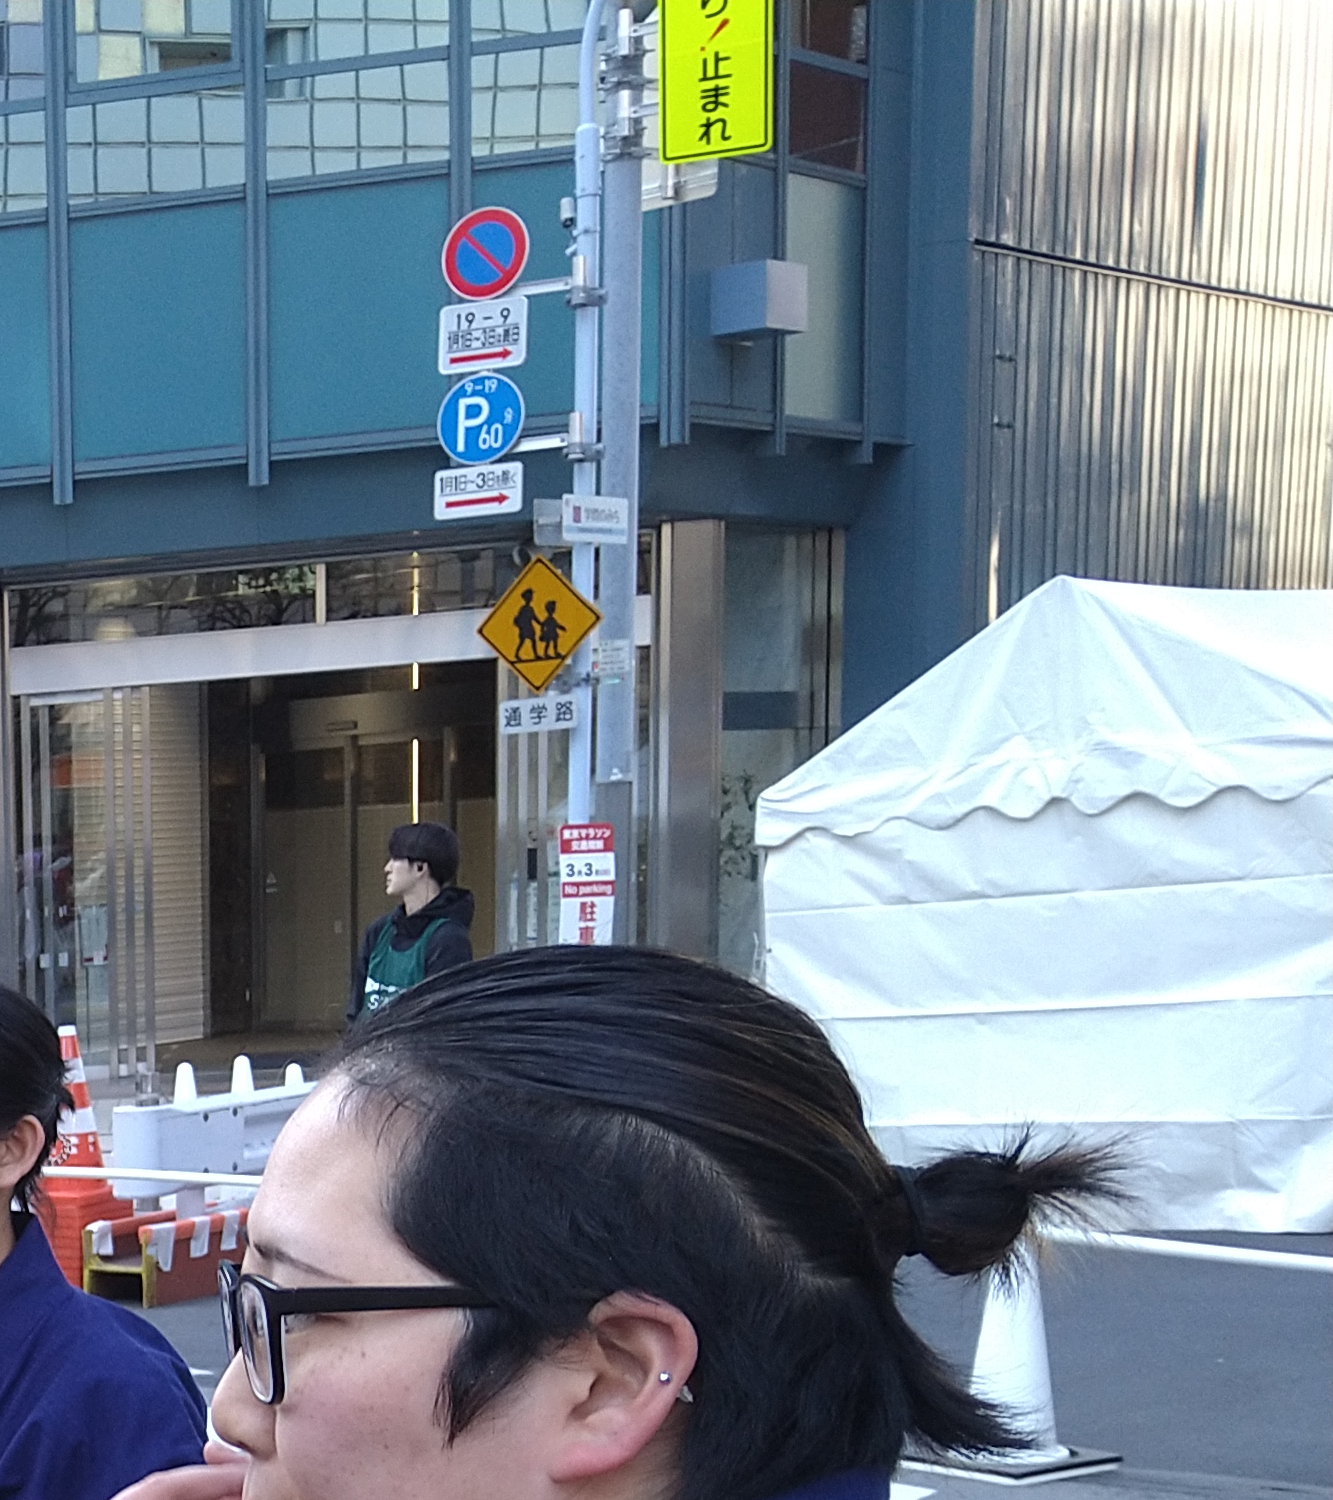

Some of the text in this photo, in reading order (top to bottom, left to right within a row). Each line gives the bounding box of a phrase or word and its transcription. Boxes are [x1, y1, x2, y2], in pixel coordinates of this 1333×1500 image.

[457, 396, 490, 452] P
[504, 700, 573, 728] 通学路
